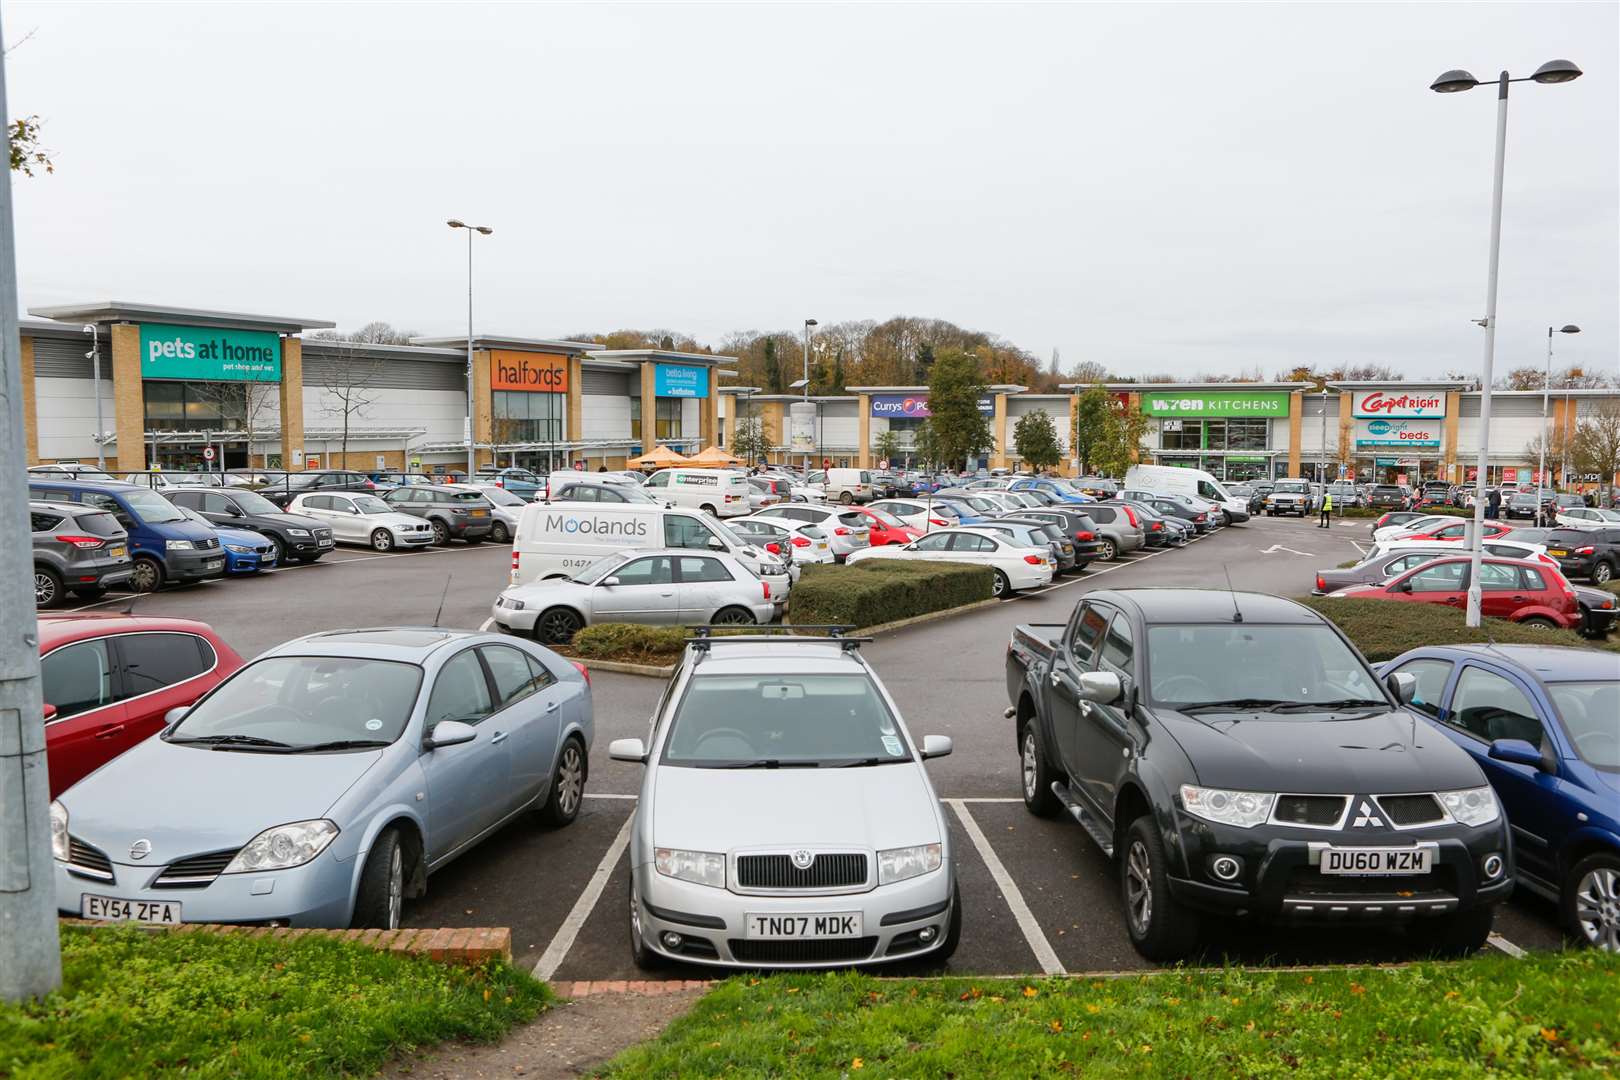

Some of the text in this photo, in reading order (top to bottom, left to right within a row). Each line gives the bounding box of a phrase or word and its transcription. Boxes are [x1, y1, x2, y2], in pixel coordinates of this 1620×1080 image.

[149, 337, 273, 362] pets at home
[498, 359, 564, 386] halfords
[873, 401, 903, 412] Currys
[1153, 399, 1279, 411] wren KITCHENS
[1400, 431, 1429, 440] beds
[678, 475, 718, 486] enterprise
[545, 515, 647, 536] Moolands
[1329, 852, 1424, 870] DU60 WZM
[90, 898, 173, 922] EY54 ZFA
[756, 916, 854, 935] TN07 MDK
